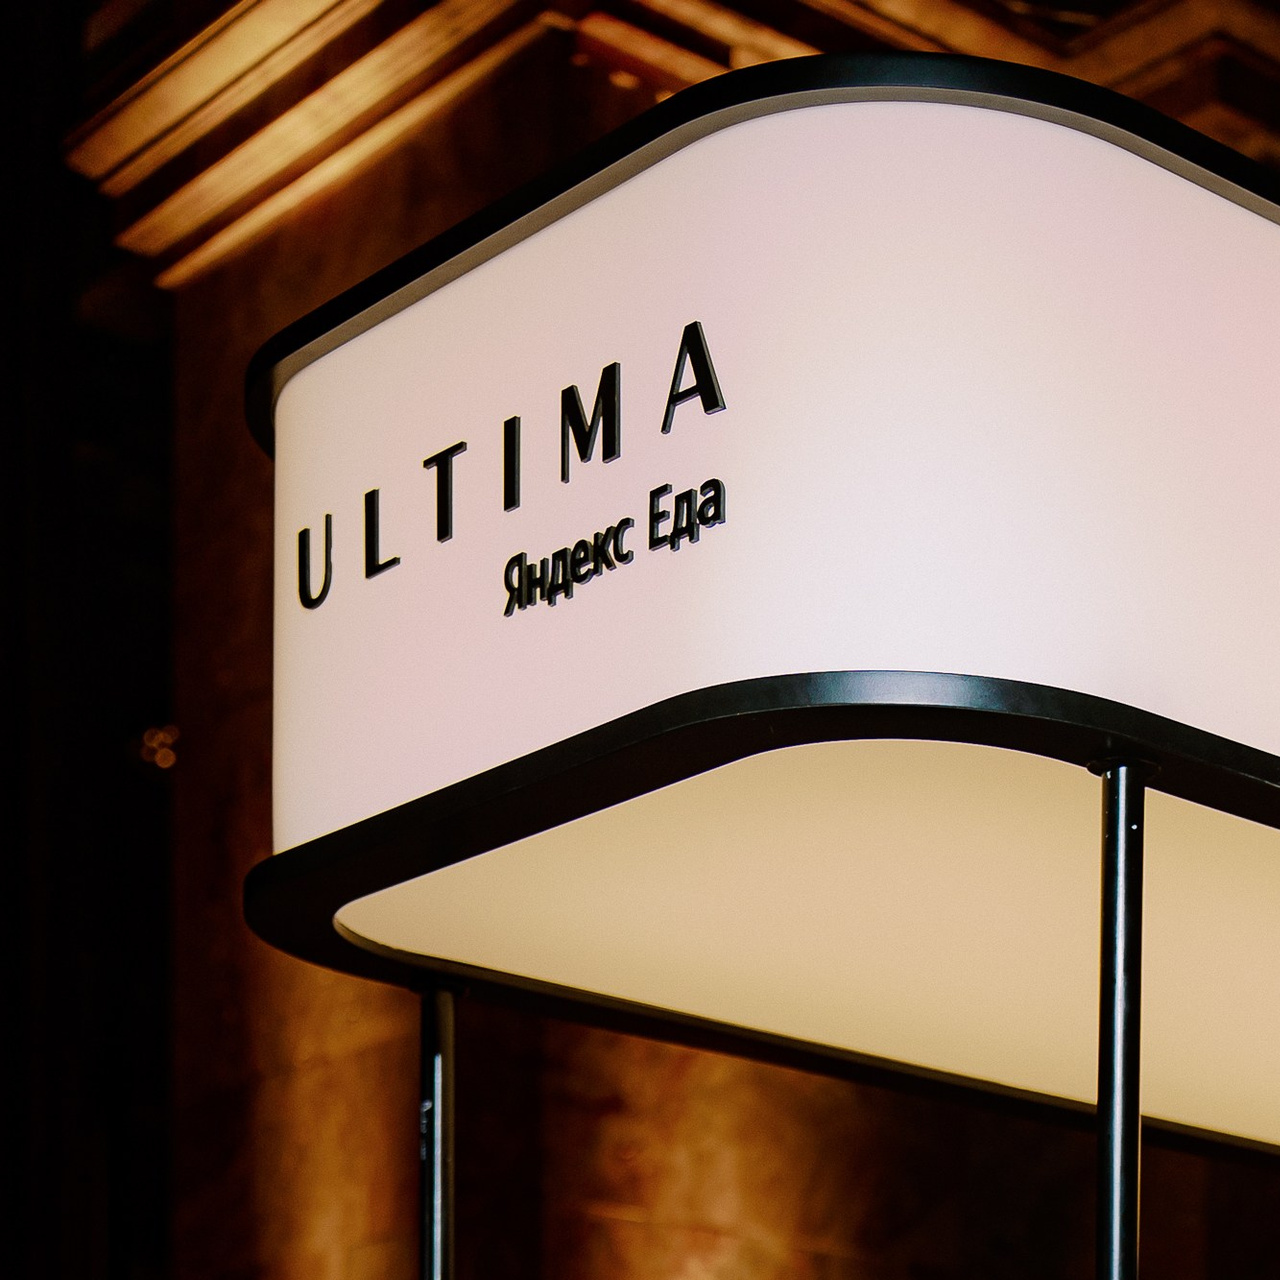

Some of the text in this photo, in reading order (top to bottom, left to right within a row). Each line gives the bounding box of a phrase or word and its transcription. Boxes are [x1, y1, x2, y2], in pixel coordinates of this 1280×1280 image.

[298, 320, 727, 610] ULTIMA
[503, 478, 727, 618] Яндекс Еда
